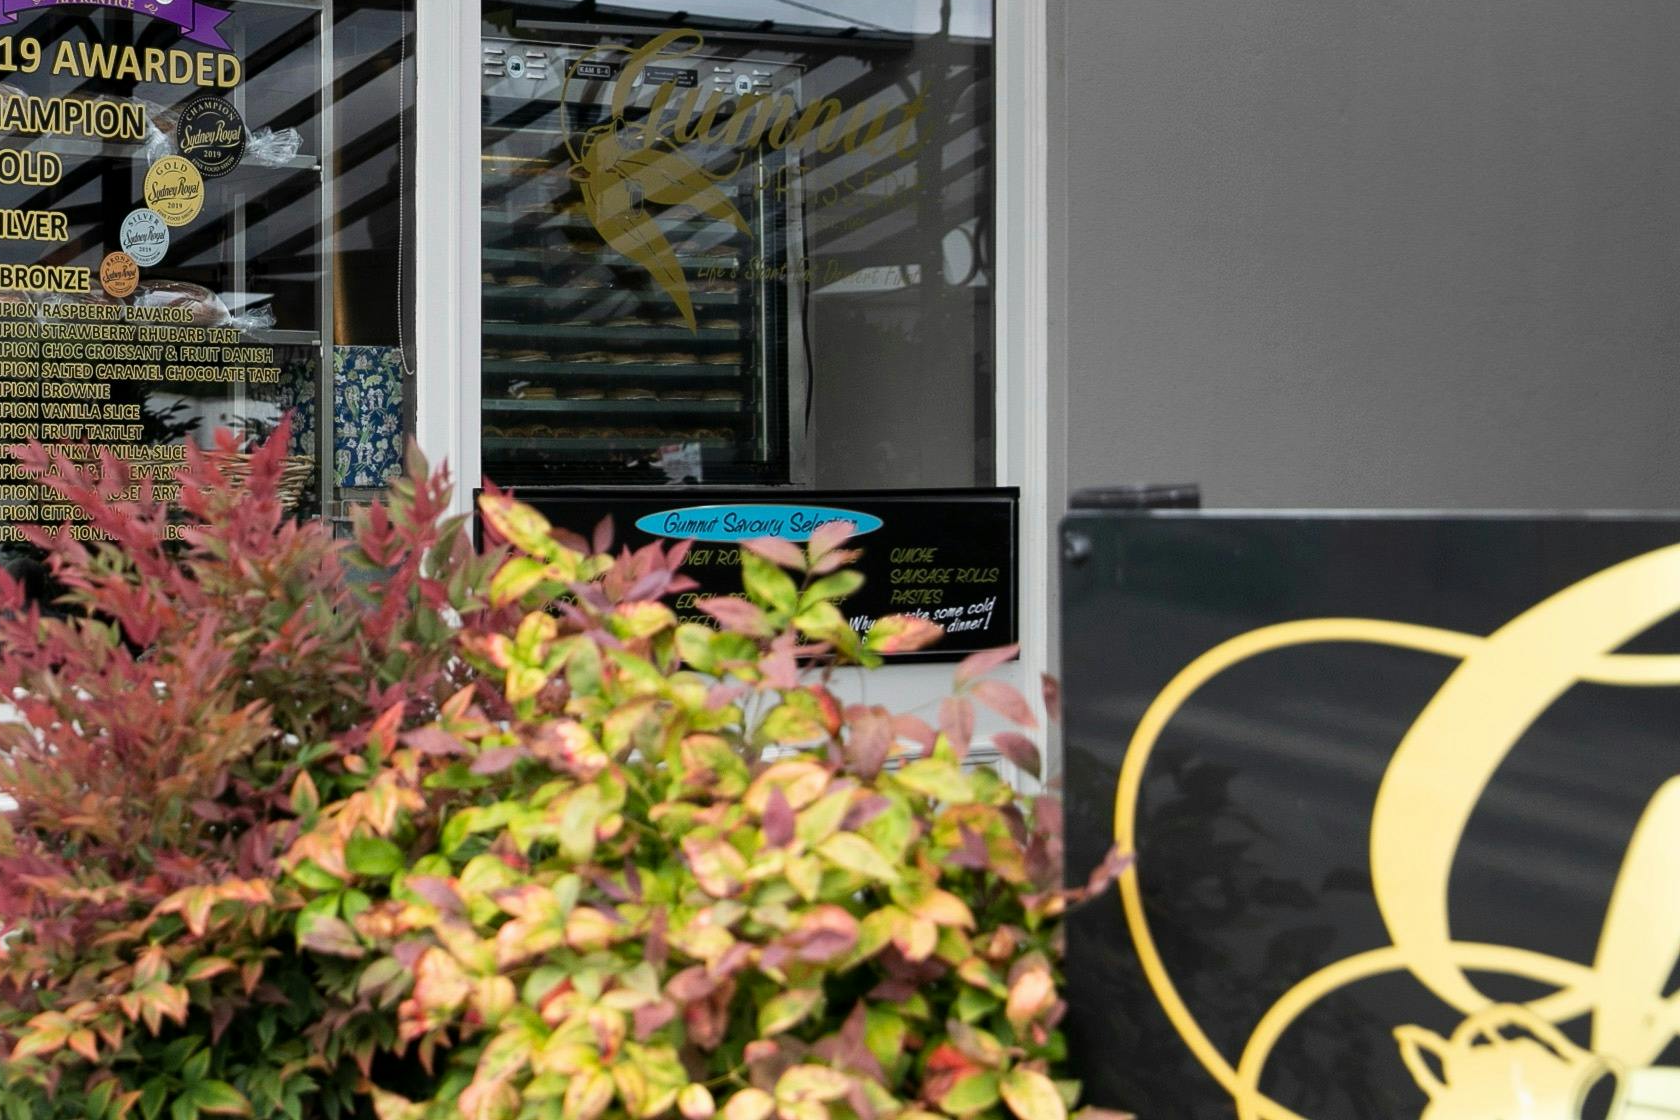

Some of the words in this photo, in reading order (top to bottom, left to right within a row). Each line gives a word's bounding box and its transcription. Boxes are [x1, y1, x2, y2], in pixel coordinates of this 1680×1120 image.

[52, 40, 242, 88] AWARDED
[186, 101, 234, 121] CHAMPION
[180, 125, 216, 151] Sydney
[215, 120, 241, 144] Royal
[203, 150, 222, 158] 2019
[156, 161, 188, 176] GOLD
[148, 181, 177, 203] Sydney
[177, 176, 200, 196] Royal
[128, 213, 160, 227] SILVER
[42, 303, 121, 320] RASPBERRY
[126, 307, 193, 322] BAVAROIS
[41, 323, 135, 340] STRAWBERRY
[139, 327, 204, 342] RHUBARB
[208, 329, 240, 343] TART
[42, 344, 83, 359] CHOC
[85, 345, 163, 361] CROISSANT
[165, 347, 177, 361] &
[180, 347, 220, 362] FRUIT
[222, 348, 273, 363] DANISH
[41, 362, 92, 378] SALTED
[96, 364, 163, 380] CARAMEL
[166, 366, 244, 382] CHOCOLATE
[247, 367, 281, 383] TART
[42, 382, 110, 399] BROWNIE
[41, 403, 101, 419] VANILLA
[103, 404, 140, 419] SLICE
[42, 424, 84, 439] FRUIT
[85, 425, 144, 440] TARTLET
[153, 444, 188, 460] SLICE
[664, 512, 718, 533] Gumnut
[723, 512, 783, 537] Savoury
[890, 548, 938, 563] QUICHE
[890, 568, 955, 584] SAUSAGE
[956, 568, 1000, 583] ROLLS
[890, 589, 944, 605] PASTIES
[933, 606, 963, 621] some
[967, 596, 996, 614] cold
[947, 611, 992, 632] dinner!
